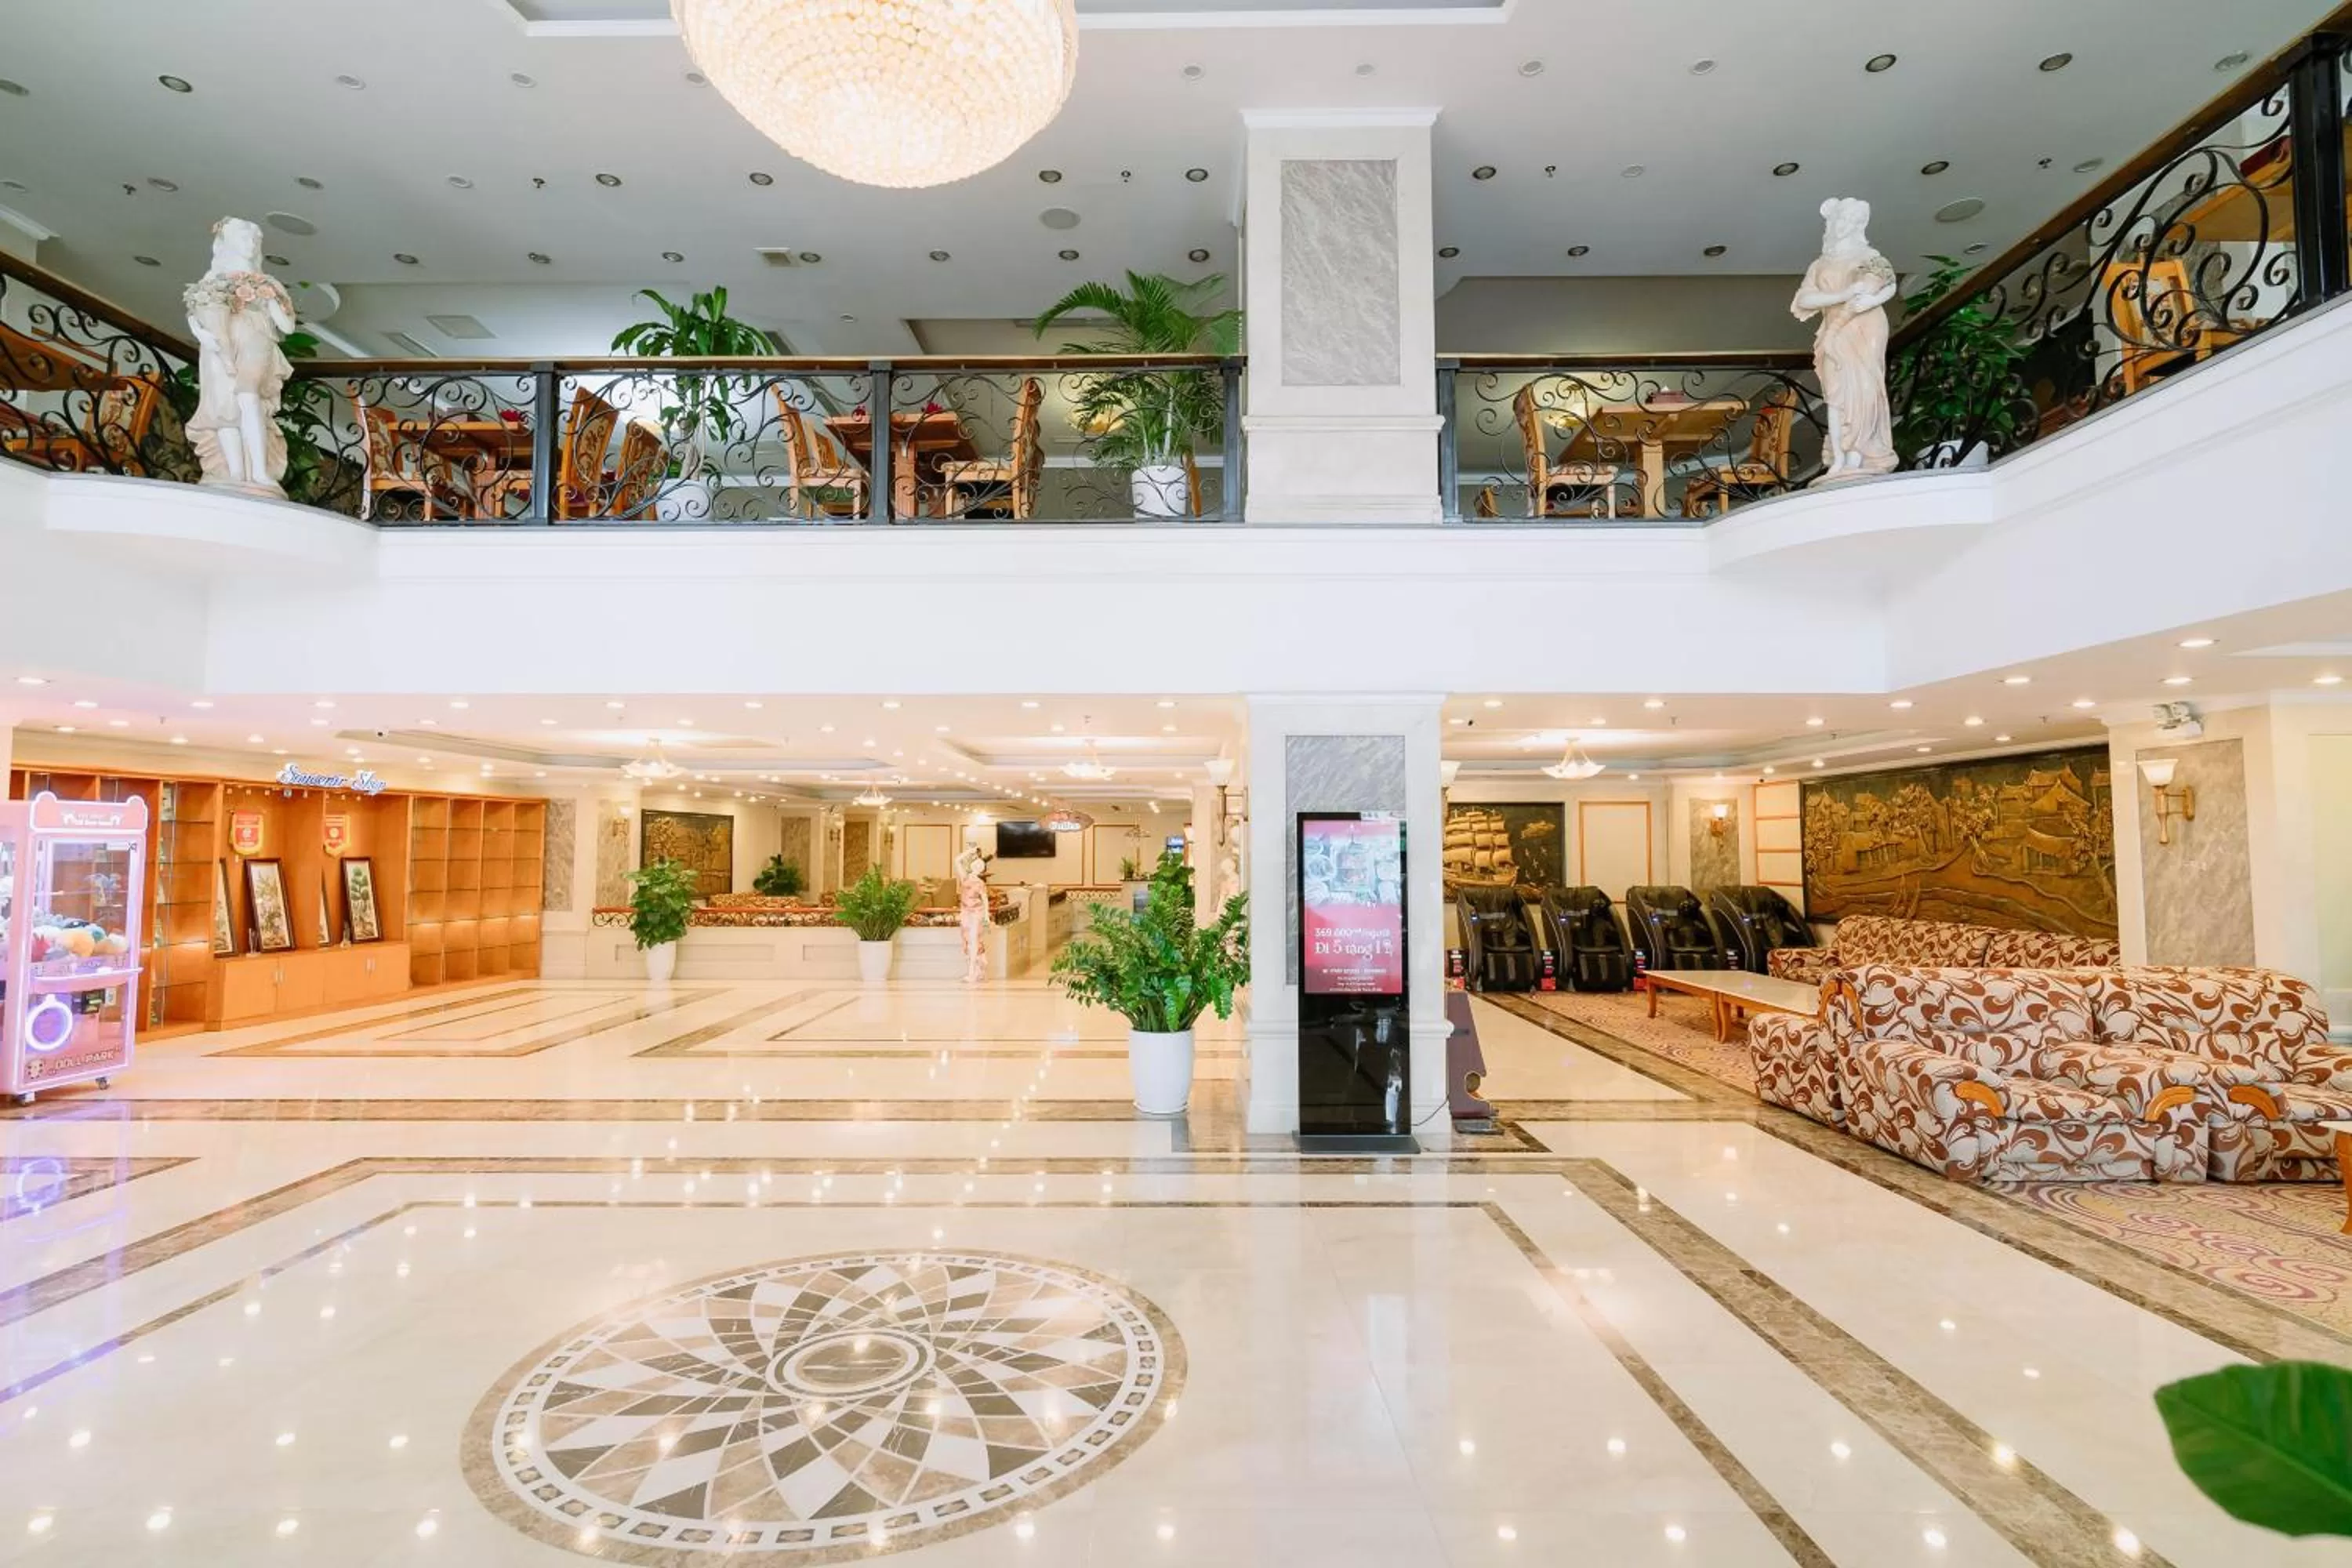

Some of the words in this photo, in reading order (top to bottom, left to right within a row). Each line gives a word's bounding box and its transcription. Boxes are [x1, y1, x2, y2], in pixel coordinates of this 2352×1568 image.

[276, 763, 348, 787] Souvenir
[351, 770, 387, 796] Shop
[1333, 940, 1342, 954] 5
[85, 1050, 114, 1063] PARK
